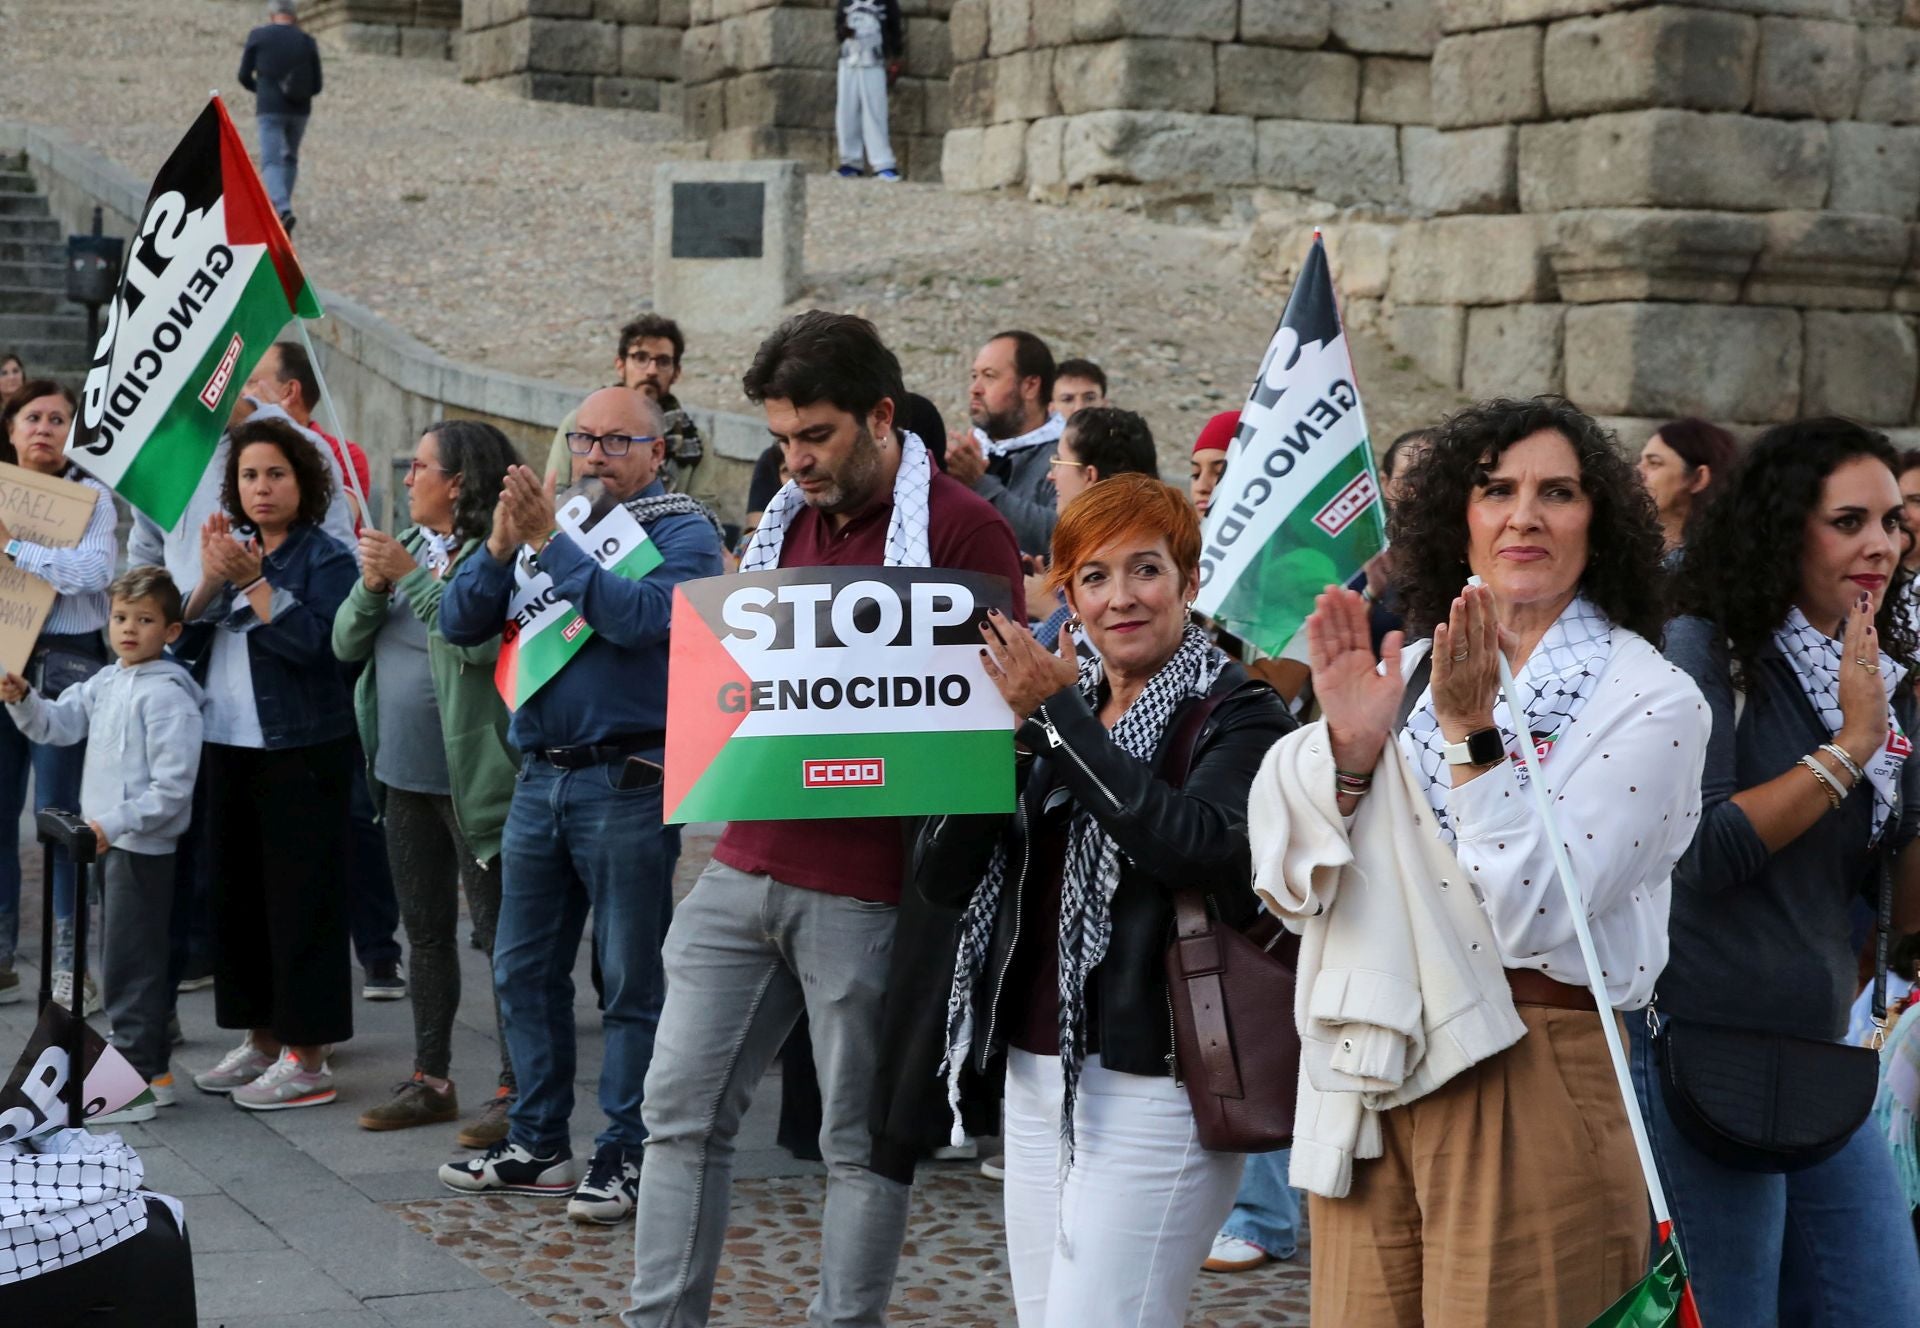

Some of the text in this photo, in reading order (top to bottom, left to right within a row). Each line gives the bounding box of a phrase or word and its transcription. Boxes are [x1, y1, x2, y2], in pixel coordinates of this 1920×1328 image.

[720, 580, 975, 650] STOP
[717, 674, 971, 714] GENOCIDIO
[809, 763, 879, 782] CCOO
